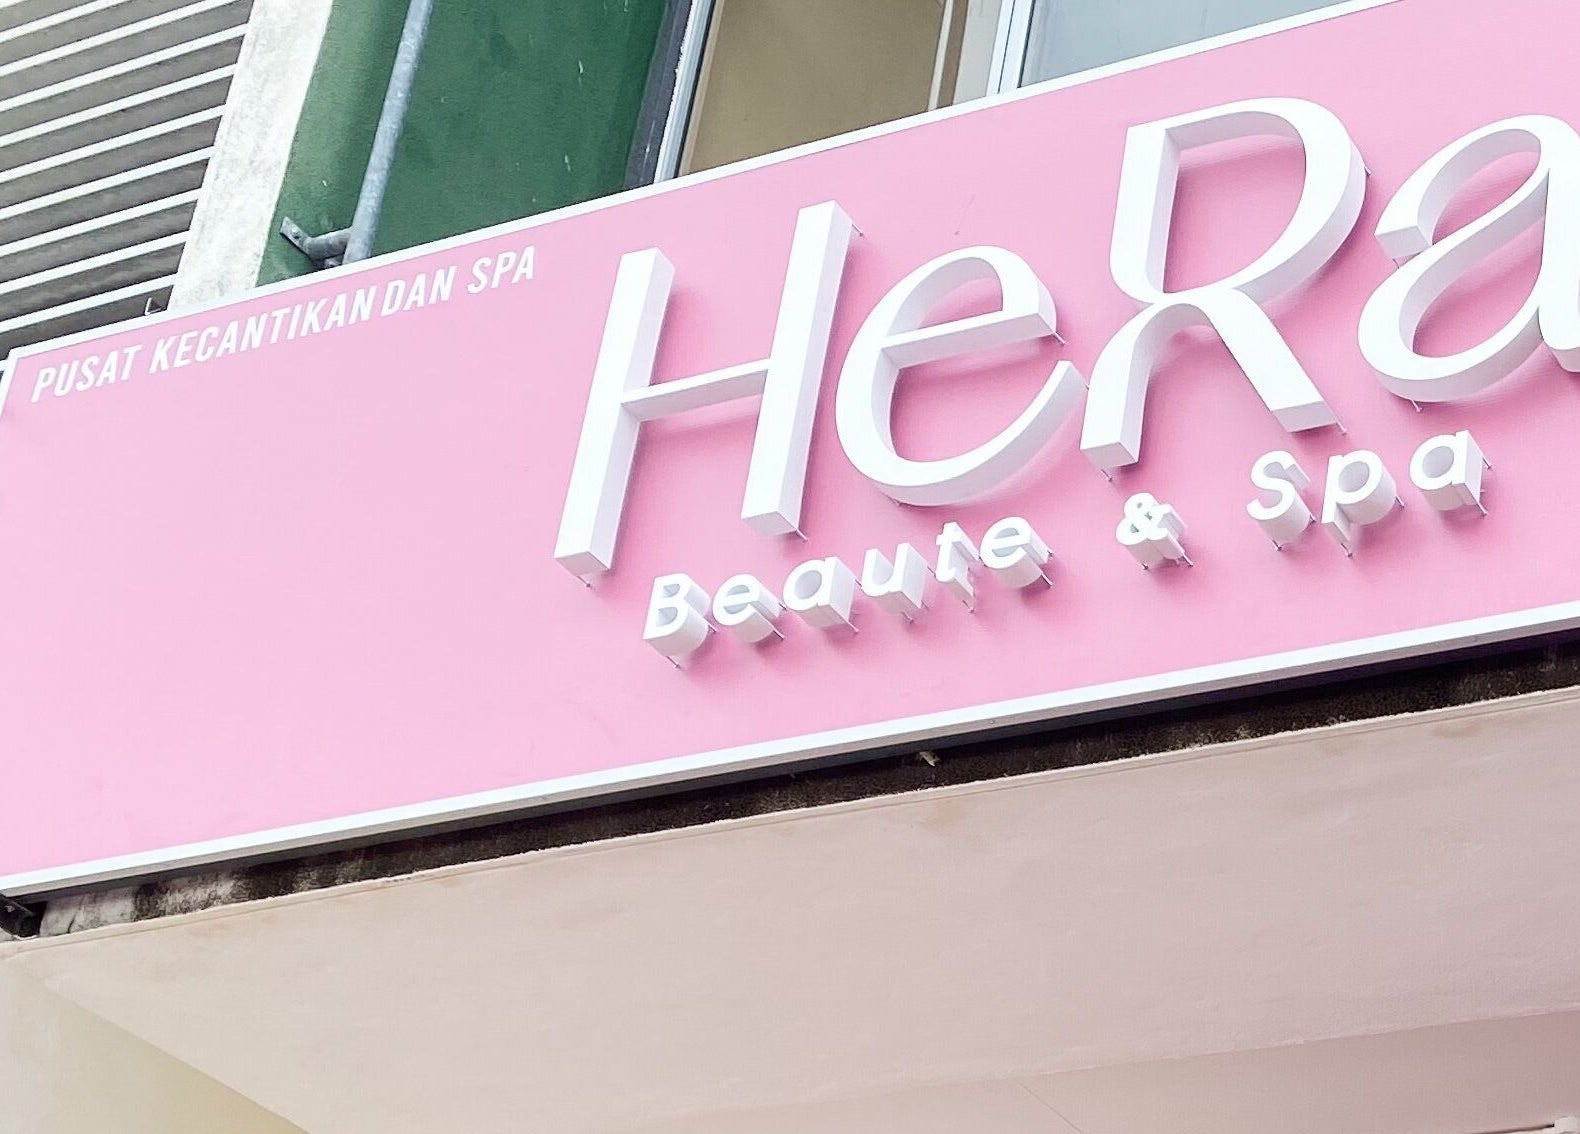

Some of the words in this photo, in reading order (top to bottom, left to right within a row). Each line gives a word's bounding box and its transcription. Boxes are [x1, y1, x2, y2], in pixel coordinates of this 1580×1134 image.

[32, 344, 142, 403] PUSAT
[150, 297, 378, 373] KECANTIKAN
[381, 265, 457, 317] DAN
[467, 245, 536, 295] SPA
[642, 516, 1051, 658] Beaute
[1116, 492, 1192, 569] &
[1247, 430, 1488, 549] Spa
